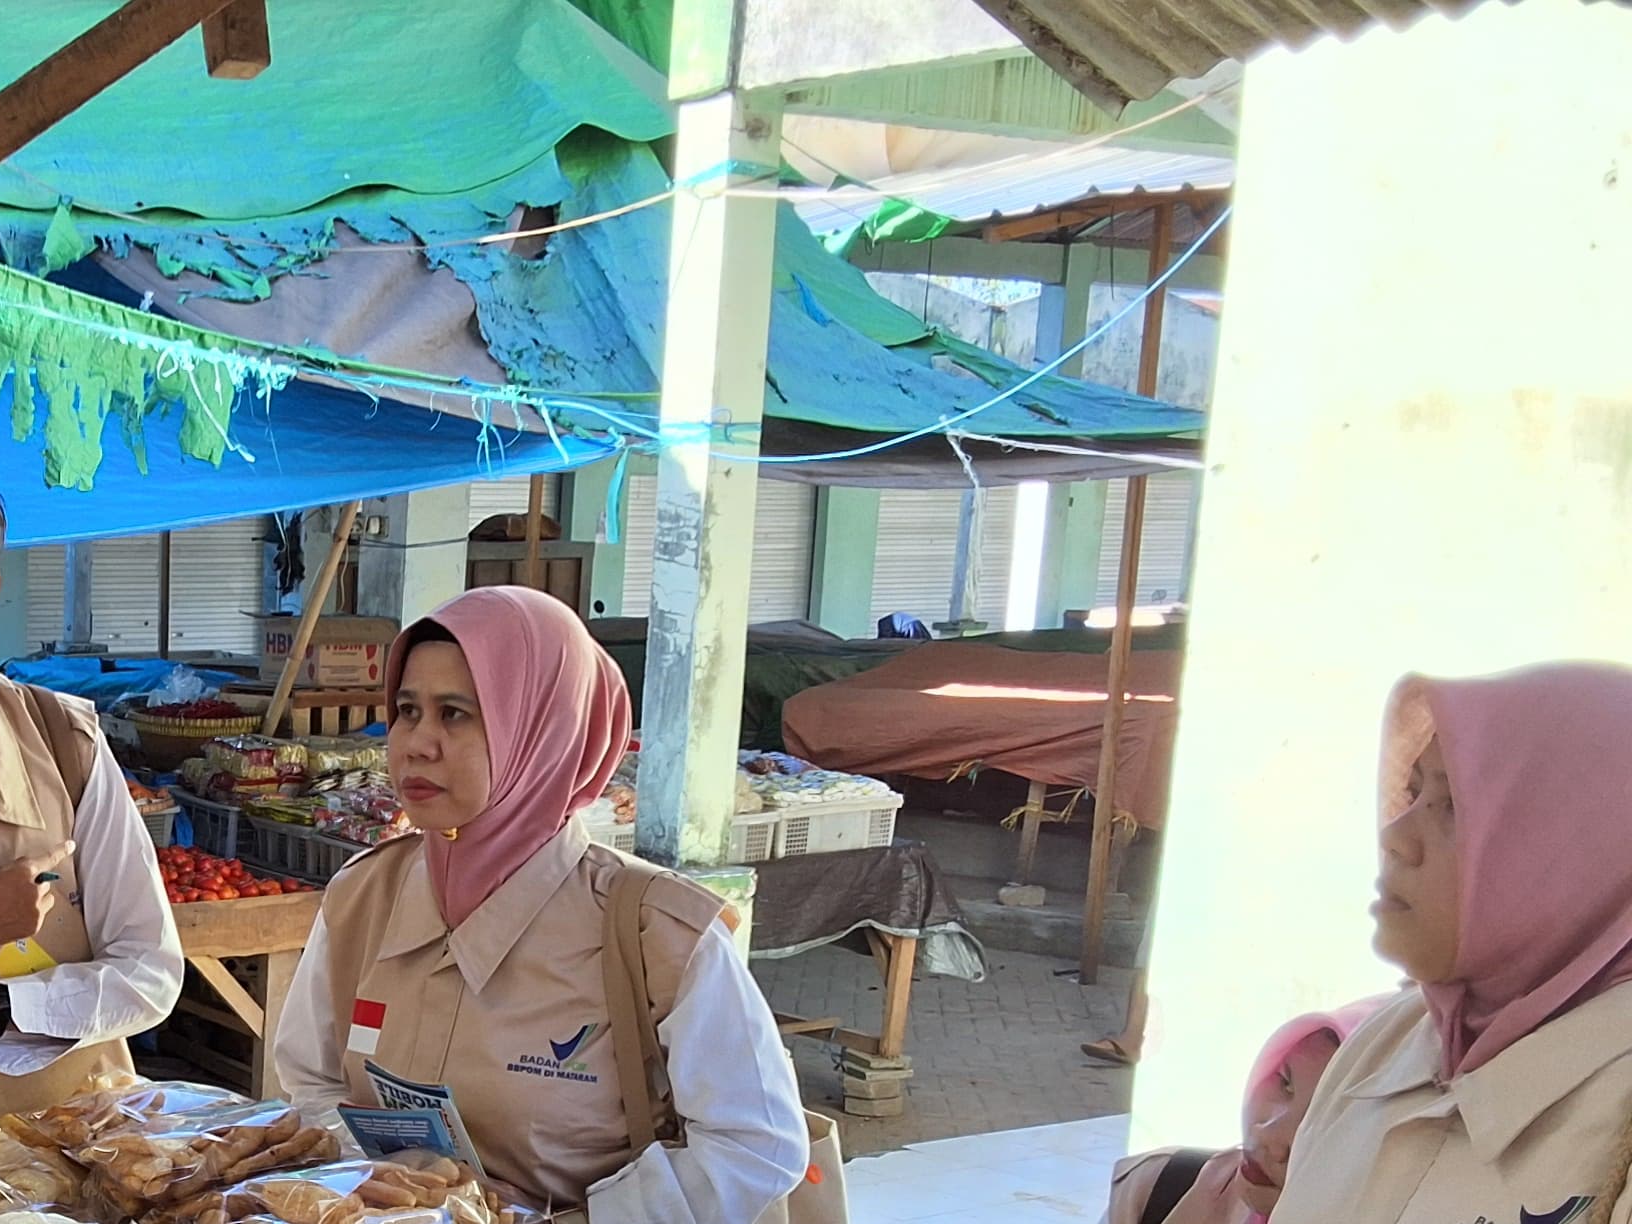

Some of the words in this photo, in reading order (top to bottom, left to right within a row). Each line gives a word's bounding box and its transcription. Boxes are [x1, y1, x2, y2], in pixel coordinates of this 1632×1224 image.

[519, 1054, 561, 1070] BADAN
[543, 1069, 555, 1078] DI
[556, 1071, 598, 1083] MATARAM
